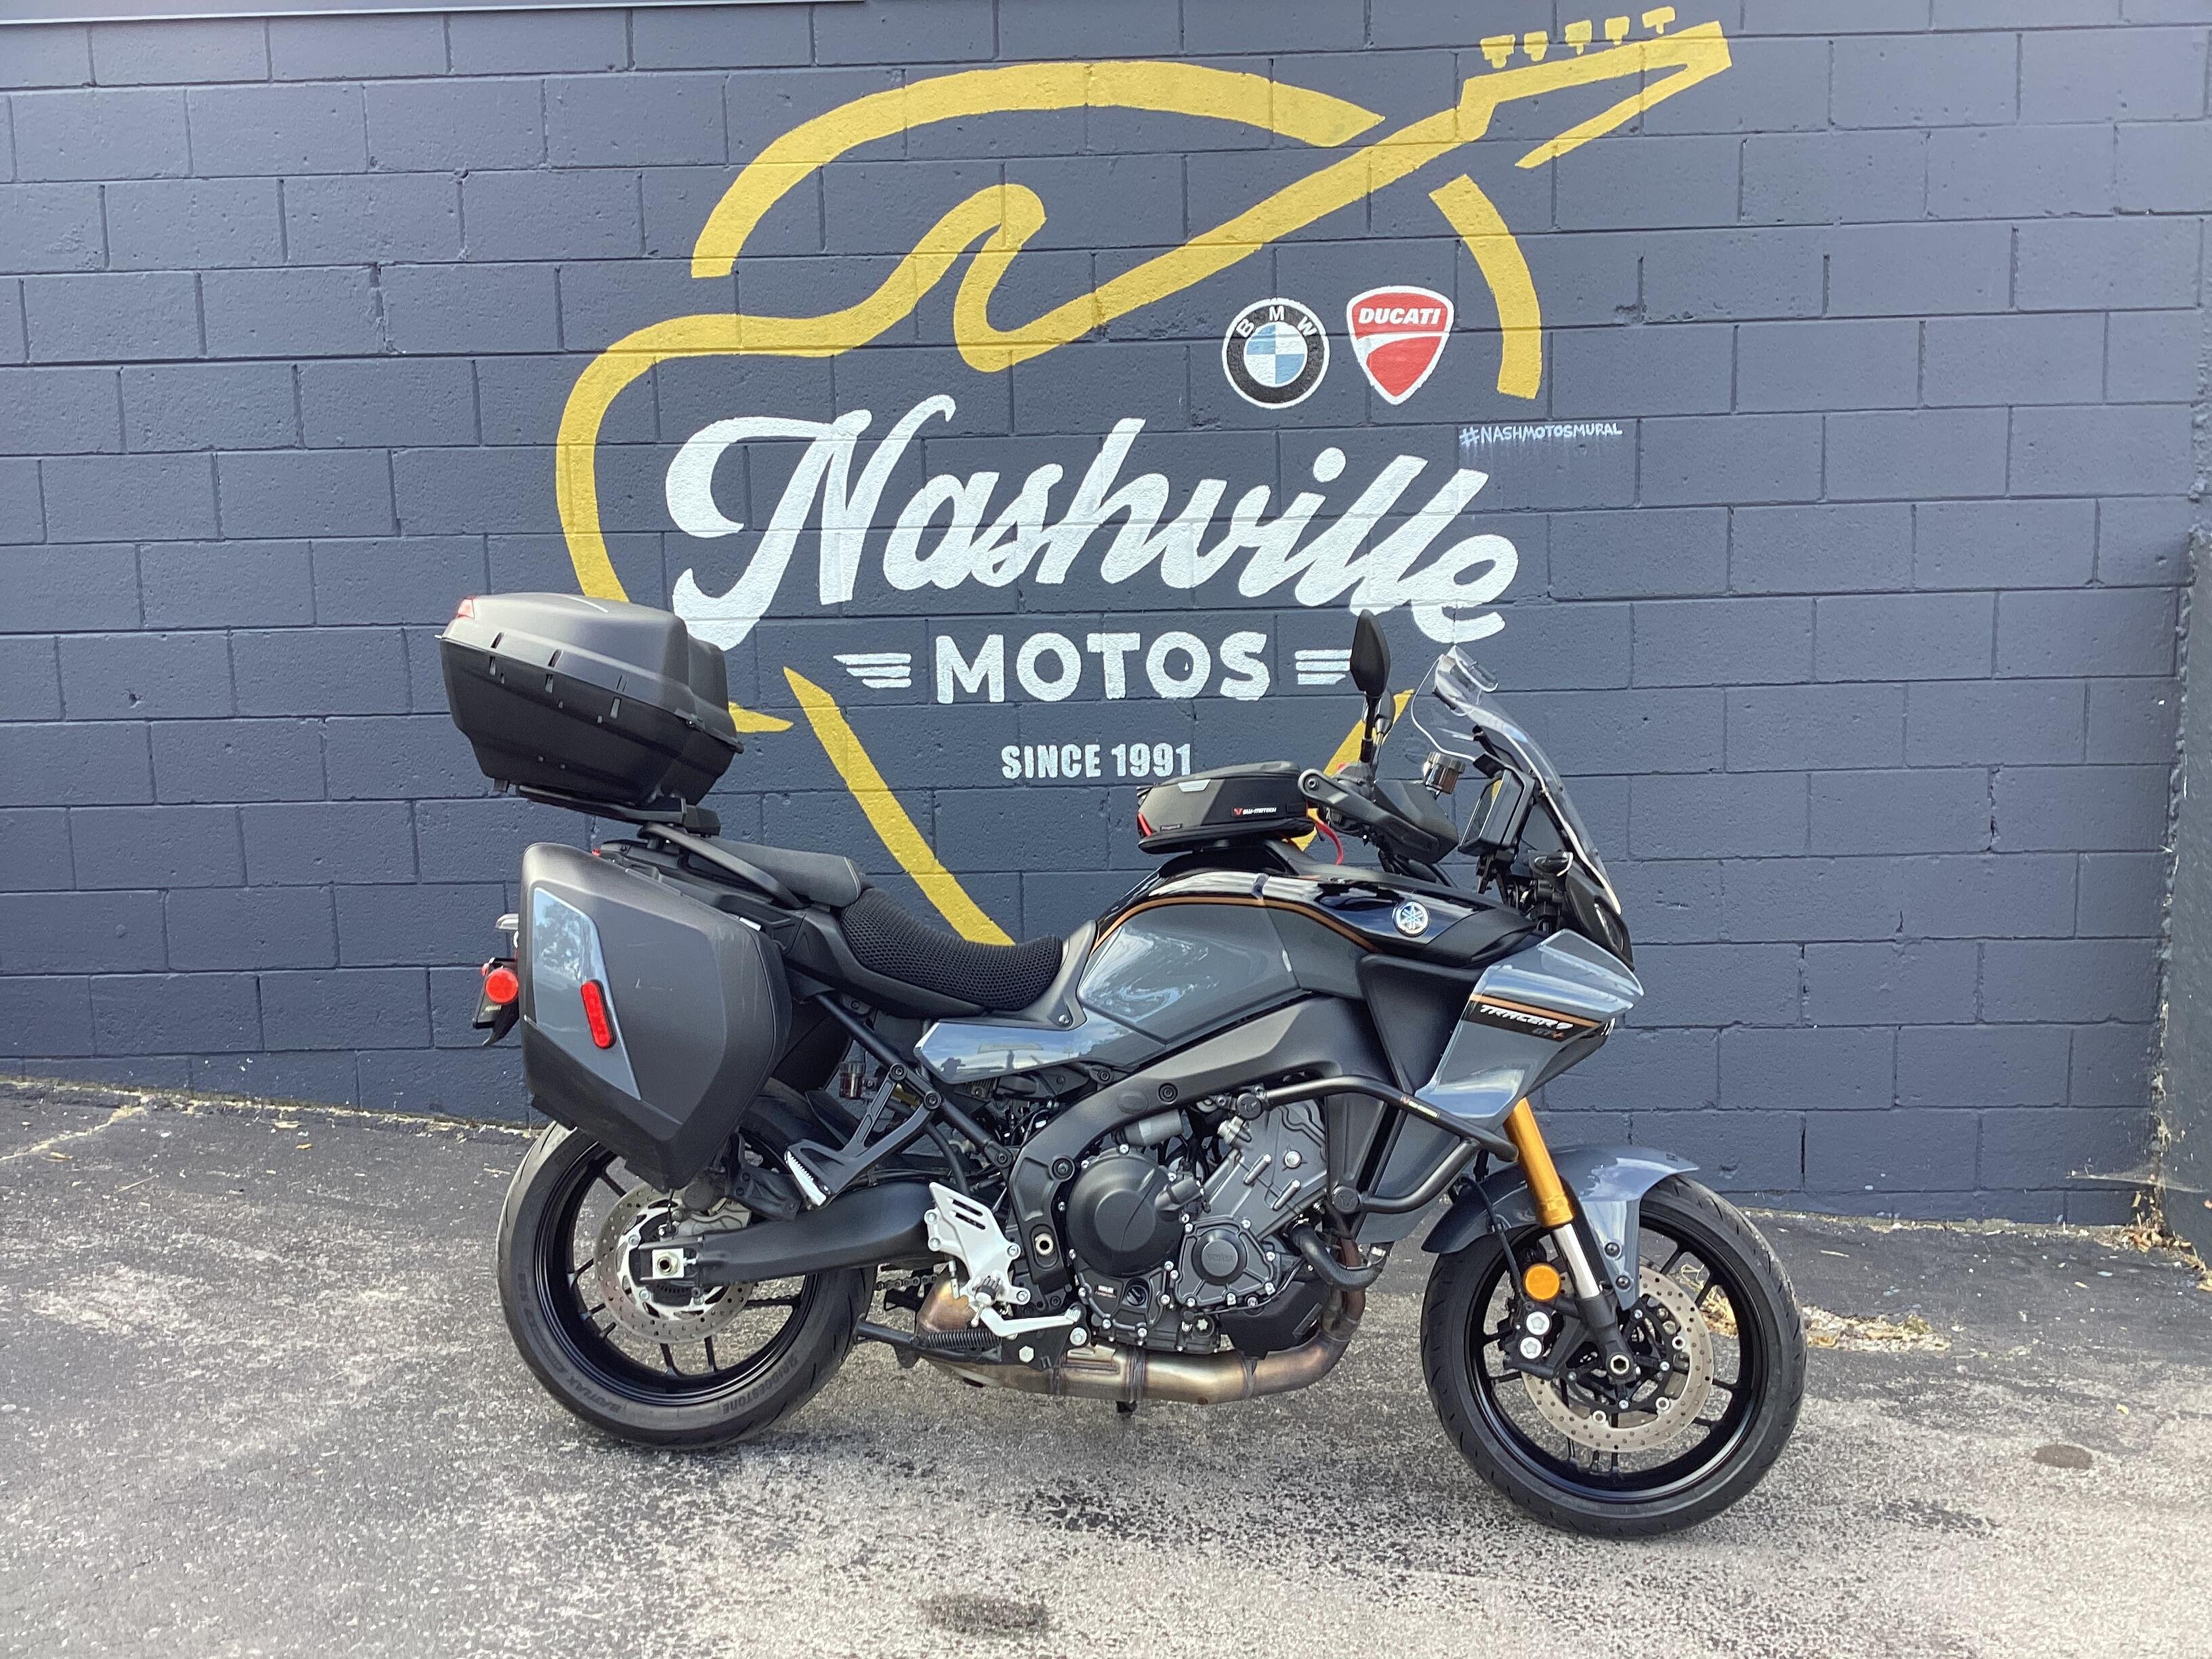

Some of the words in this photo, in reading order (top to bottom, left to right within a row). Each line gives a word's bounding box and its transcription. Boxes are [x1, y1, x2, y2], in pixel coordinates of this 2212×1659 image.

[1235, 305, 1317, 338] BMW
[1358, 307, 1442, 325] DUCATI
[1458, 422, 1623, 448] #NASHMOTOSMURAL
[665, 394, 1519, 651] Nashville
[935, 631, 1271, 704] MOTOS
[1001, 743, 1102, 779] SINCE
[1111, 742, 1191, 778] 1991
